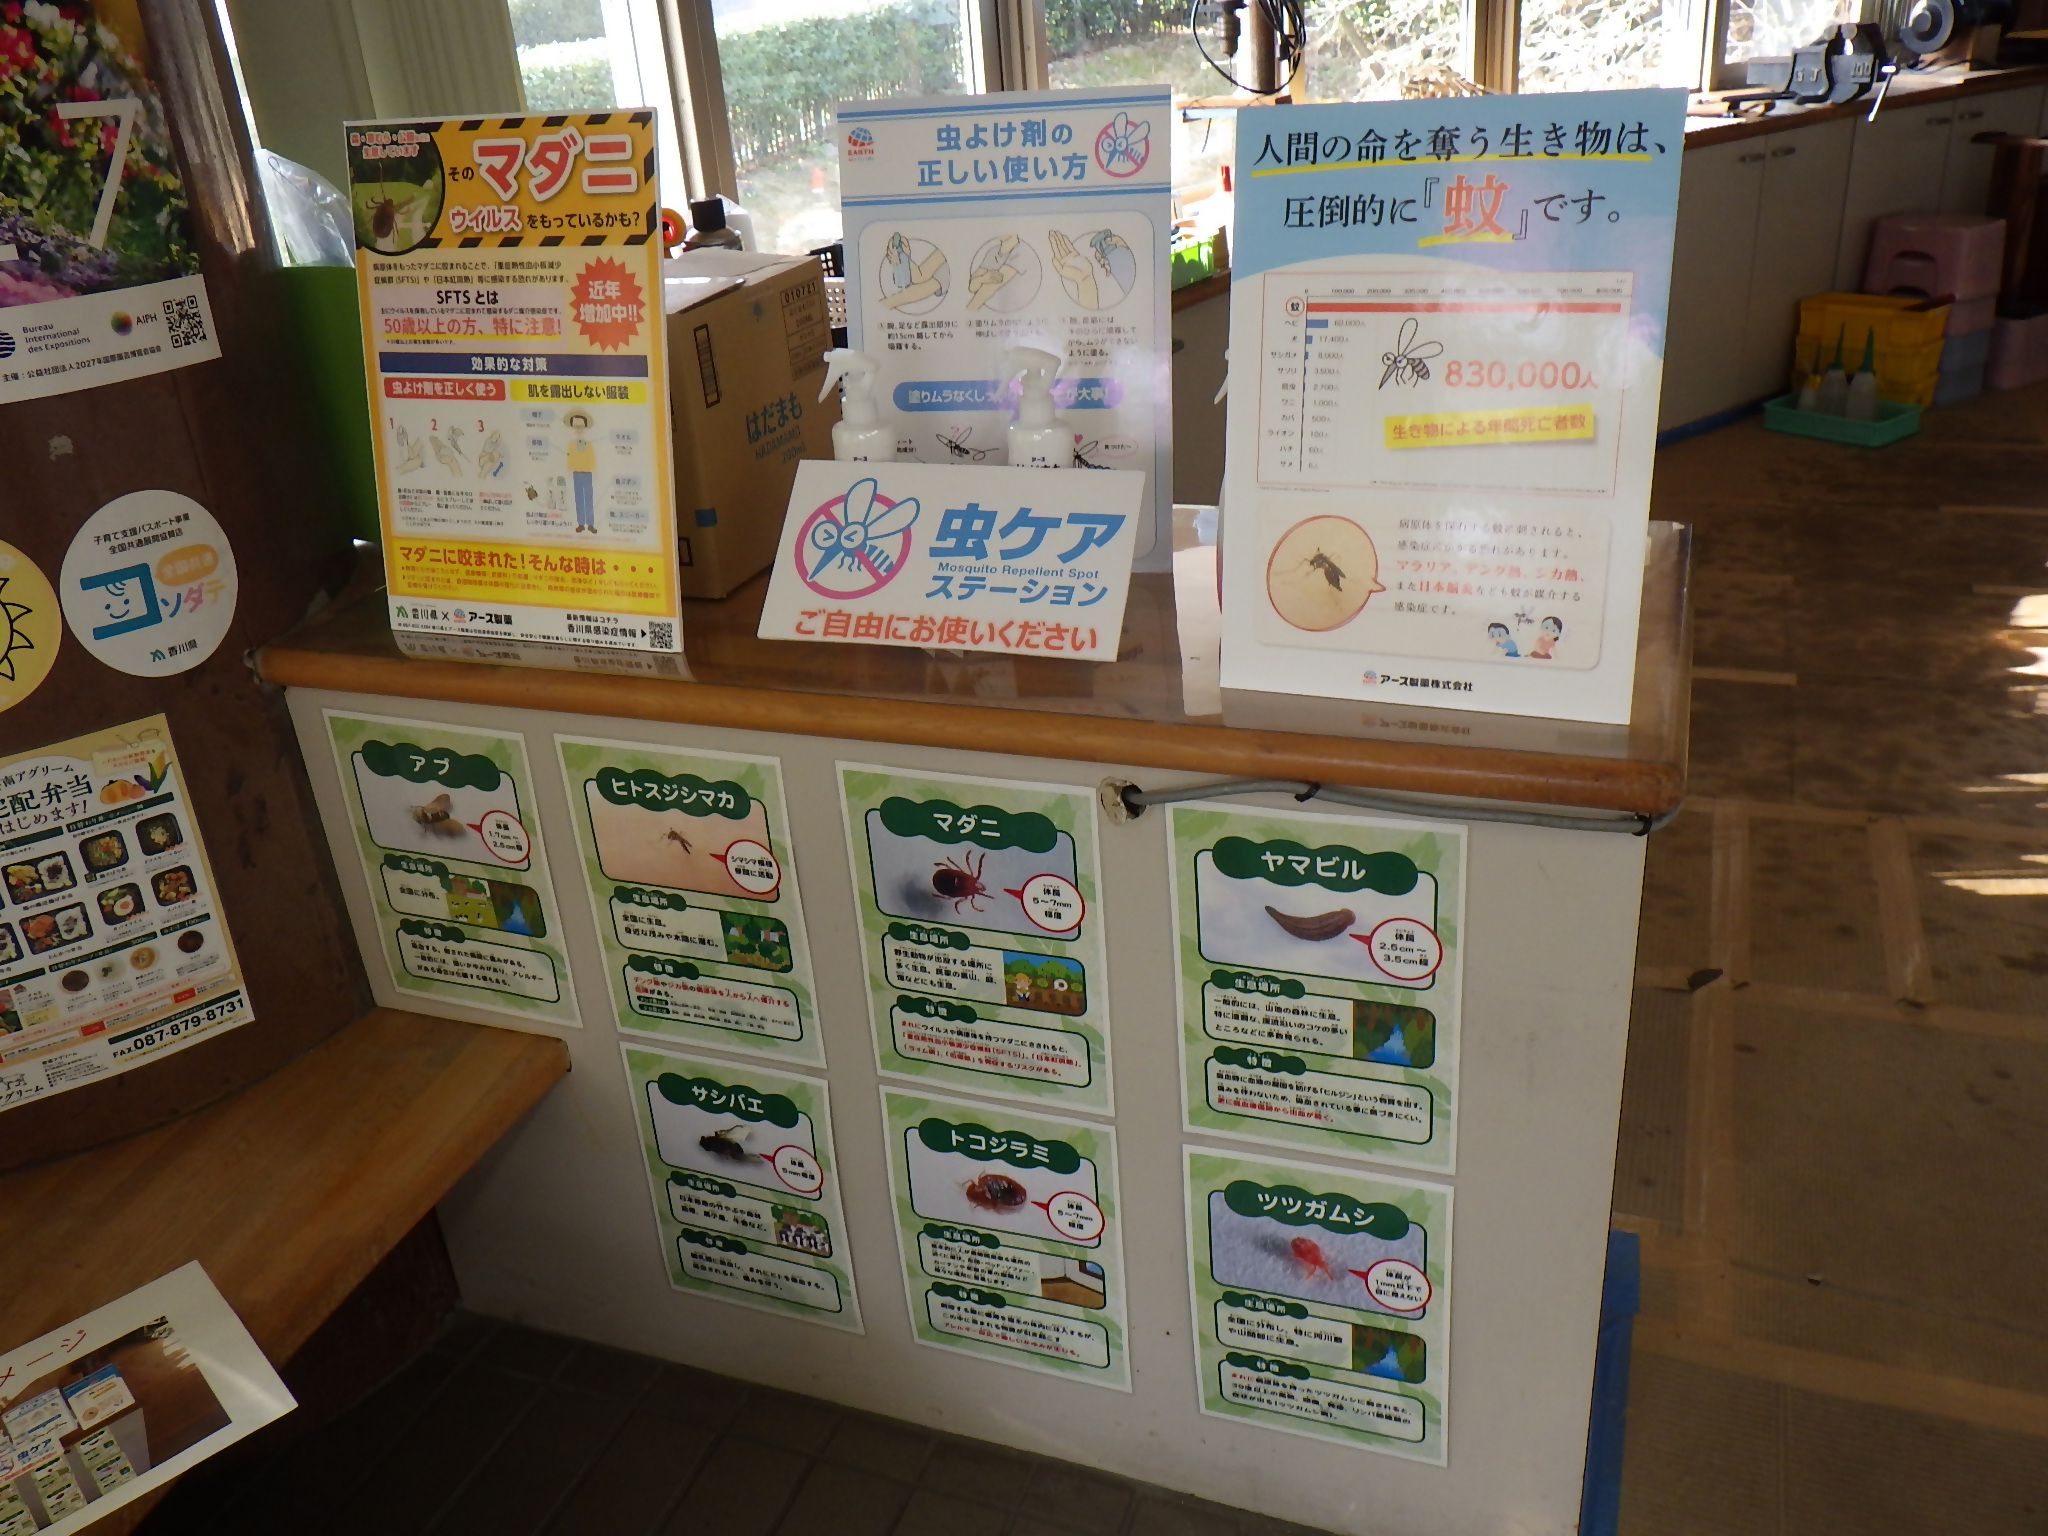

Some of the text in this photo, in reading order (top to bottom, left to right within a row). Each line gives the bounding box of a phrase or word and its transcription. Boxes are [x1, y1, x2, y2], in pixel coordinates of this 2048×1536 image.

[936, 120, 1073, 150] 虫よけ剤の
[1252, 121, 1668, 166] 人間の命を奪う生き物は、
[918, 153, 1088, 186] 正しい使い方
[1283, 174, 1620, 240] 圧倒的に『蚊』です。
[588, 281, 621, 299] 近年
[784, 282, 816, 304] 010721
[1290, 302, 1300, 312] 蚊
[23, 324, 54, 334] Bureau
[136, 313, 157, 326] AIPH
[25, 328, 80, 344] International
[28, 337, 90, 354] des Expositions
[471, 356, 548, 372] 効果的な対策
[1444, 360, 1598, 390] 830,000人
[392, 380, 496, 398] 虫よけ剤を正しく使う
[528, 384, 630, 400] 肌を露出しない服装
[431, 419, 438, 431] 2
[478, 420, 484, 432] 3
[746, 392, 802, 444] はだまも
[1392, 414, 1587, 440] 生き物による年間死亡者数
[94, 512, 190, 545] 子育て支援パスポート事業
[930, 503, 1126, 564] 虫ケア
[938, 563, 1099, 580] Mosquito Repellent Spot
[926, 575, 1108, 607] ステーション
[412, 608, 513, 625] 香川県 アース製薬
[1394, 601, 1456, 616] 感染症です。
[568, 624, 637, 638] 香川県感染症情報
[794, 610, 1097, 651] ご自由にお使いください
[168, 638, 198, 657] 香川県
[1380, 675, 1472, 692] アース製薬株式会社
[410, 755, 450, 776] アブ
[611, 778, 734, 810] ヒトスジシマカ
[933, 812, 1000, 838] マダニ
[1260, 851, 1366, 880] ヤマビル
[692, 1085, 764, 1114] サシバエ
[951, 1129, 1050, 1164] トコジラミ
[1257, 1193, 1374, 1226] ツツガムシ
